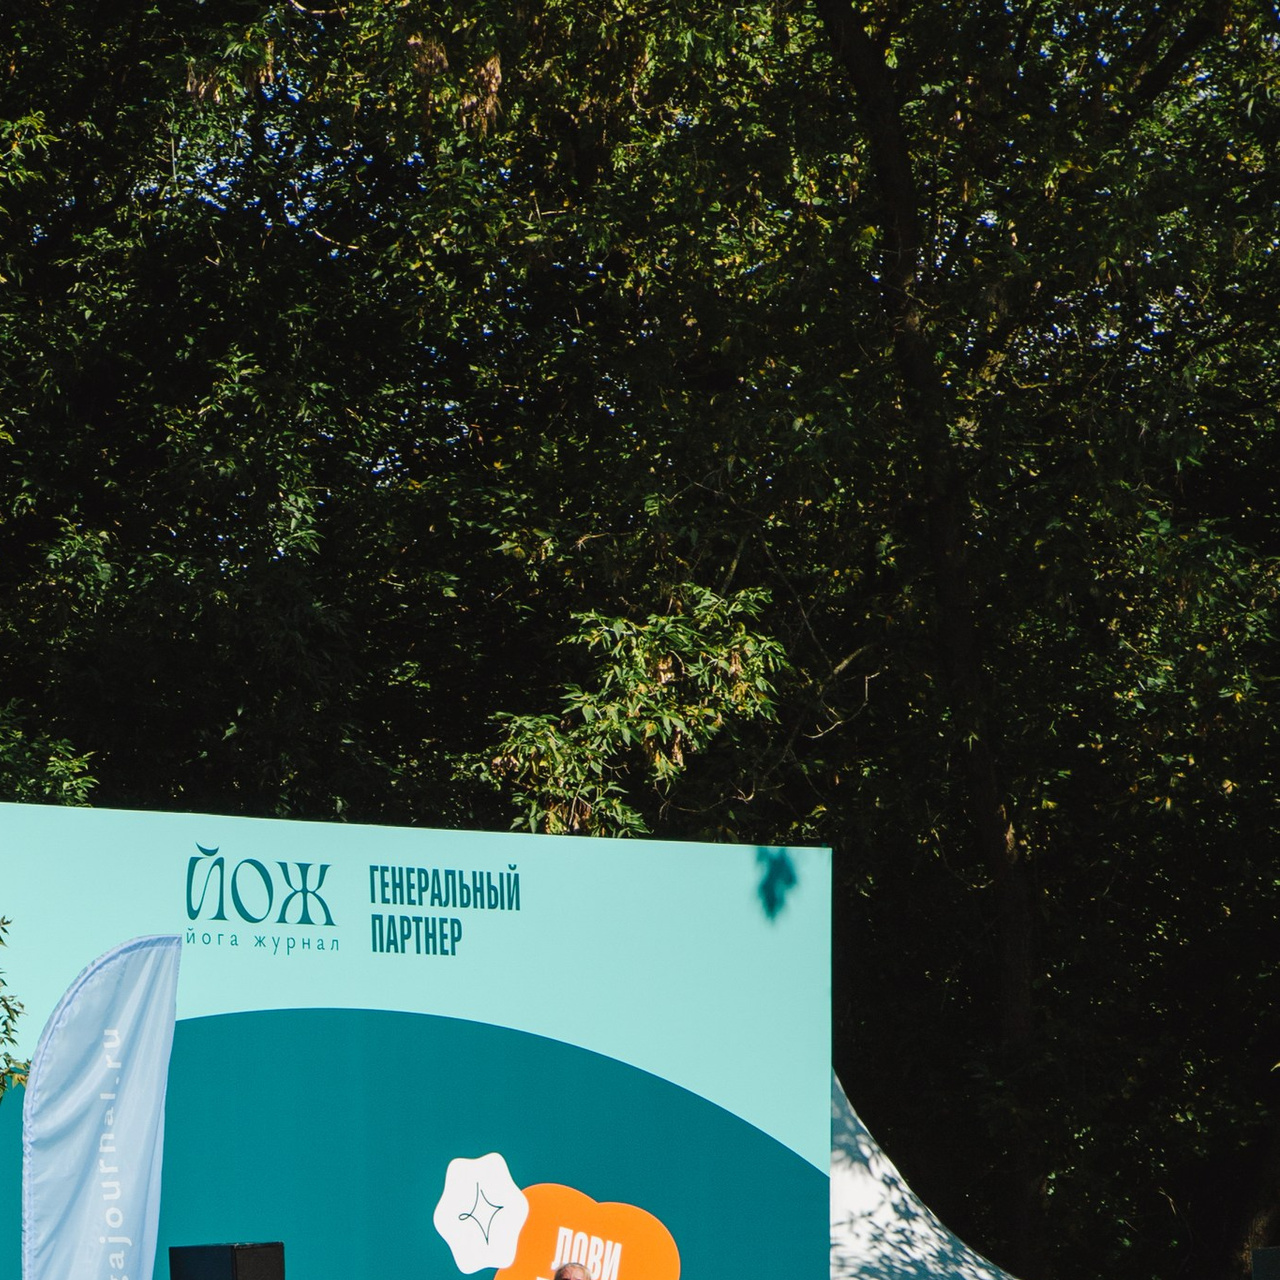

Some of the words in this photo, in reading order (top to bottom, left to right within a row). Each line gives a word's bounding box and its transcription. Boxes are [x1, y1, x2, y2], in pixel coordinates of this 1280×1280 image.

[186, 841, 339, 926] ЙОЖ
[369, 864, 521, 911] ГЕНЕРАЛЬНЫЙ
[186, 927, 239, 947] йога
[254, 934, 340, 956] журнал
[371, 913, 463, 956] ПАРТНЕР
